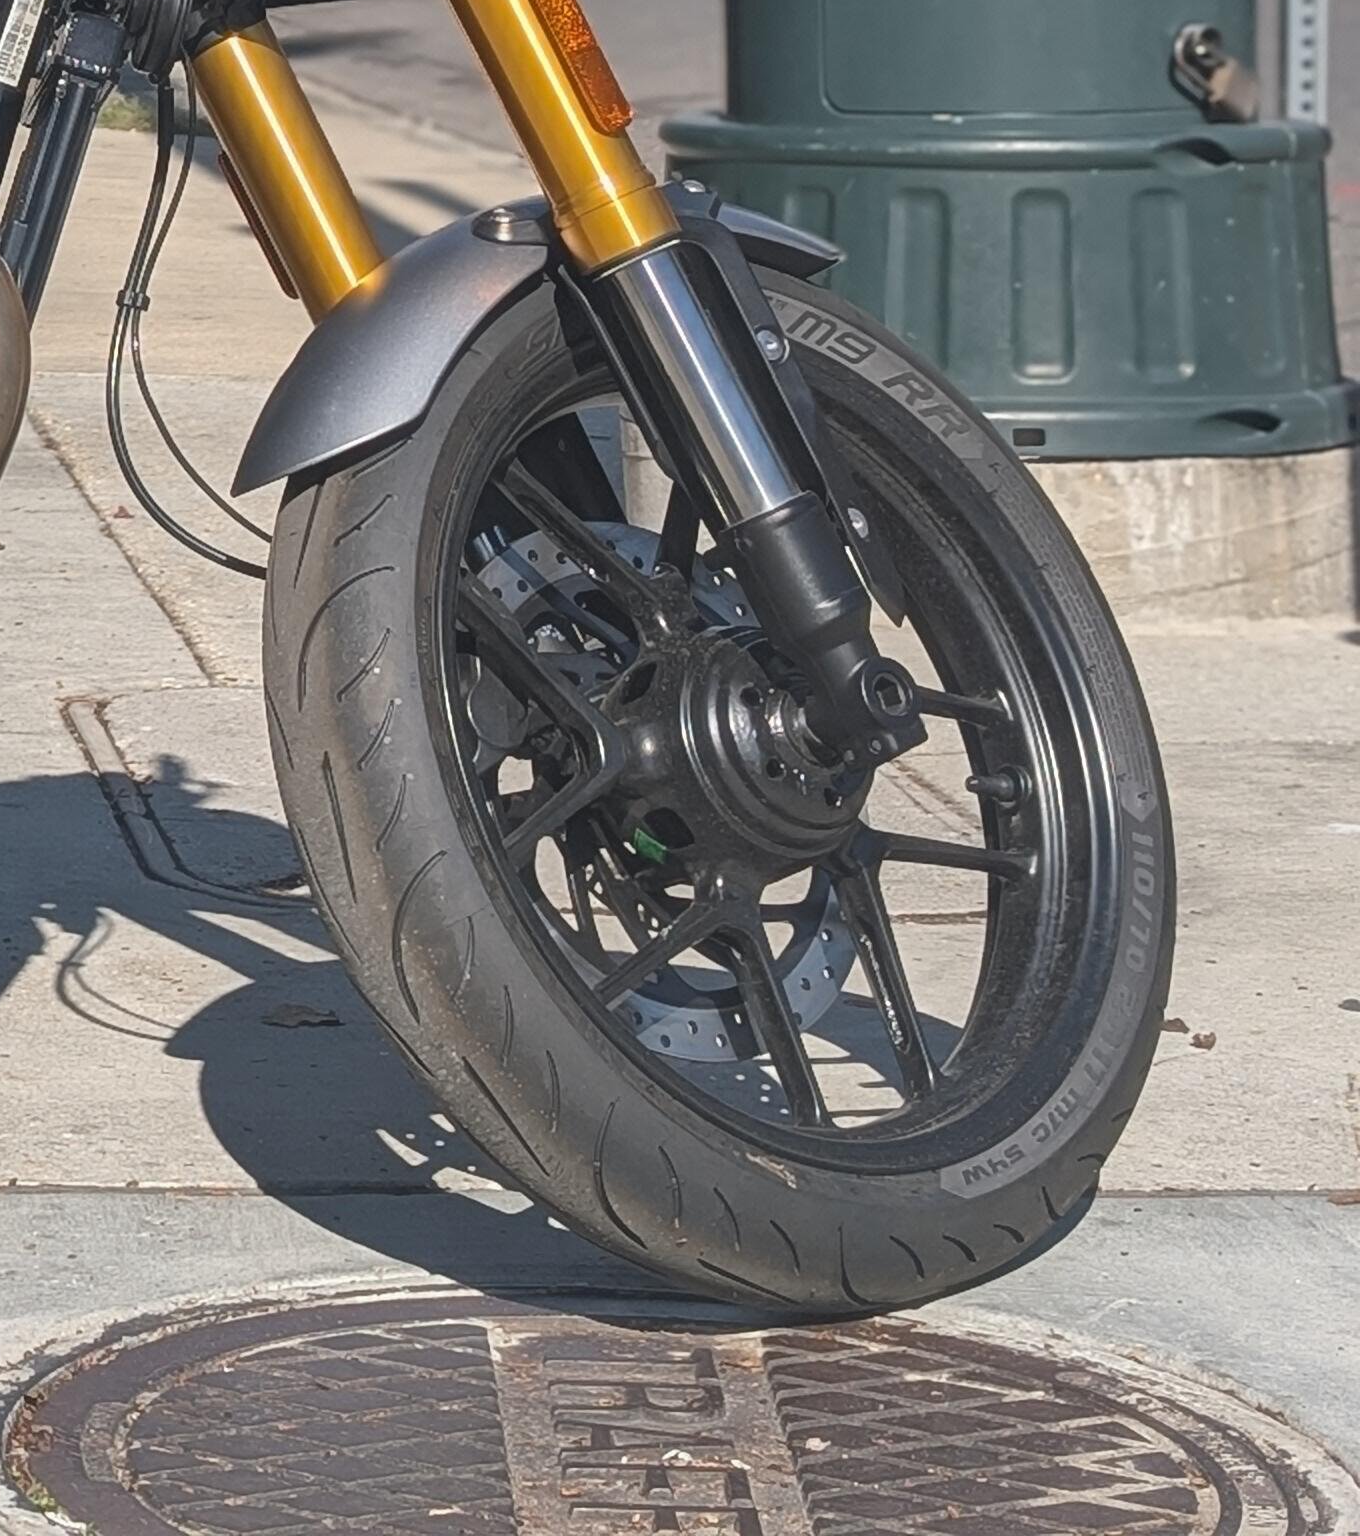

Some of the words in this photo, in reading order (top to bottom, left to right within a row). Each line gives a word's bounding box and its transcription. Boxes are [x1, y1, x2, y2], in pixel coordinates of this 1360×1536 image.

[881, 371, 972, 439] RR
[1124, 831, 1155, 973] 110/70
[961, 1143, 1026, 1186] 54W
